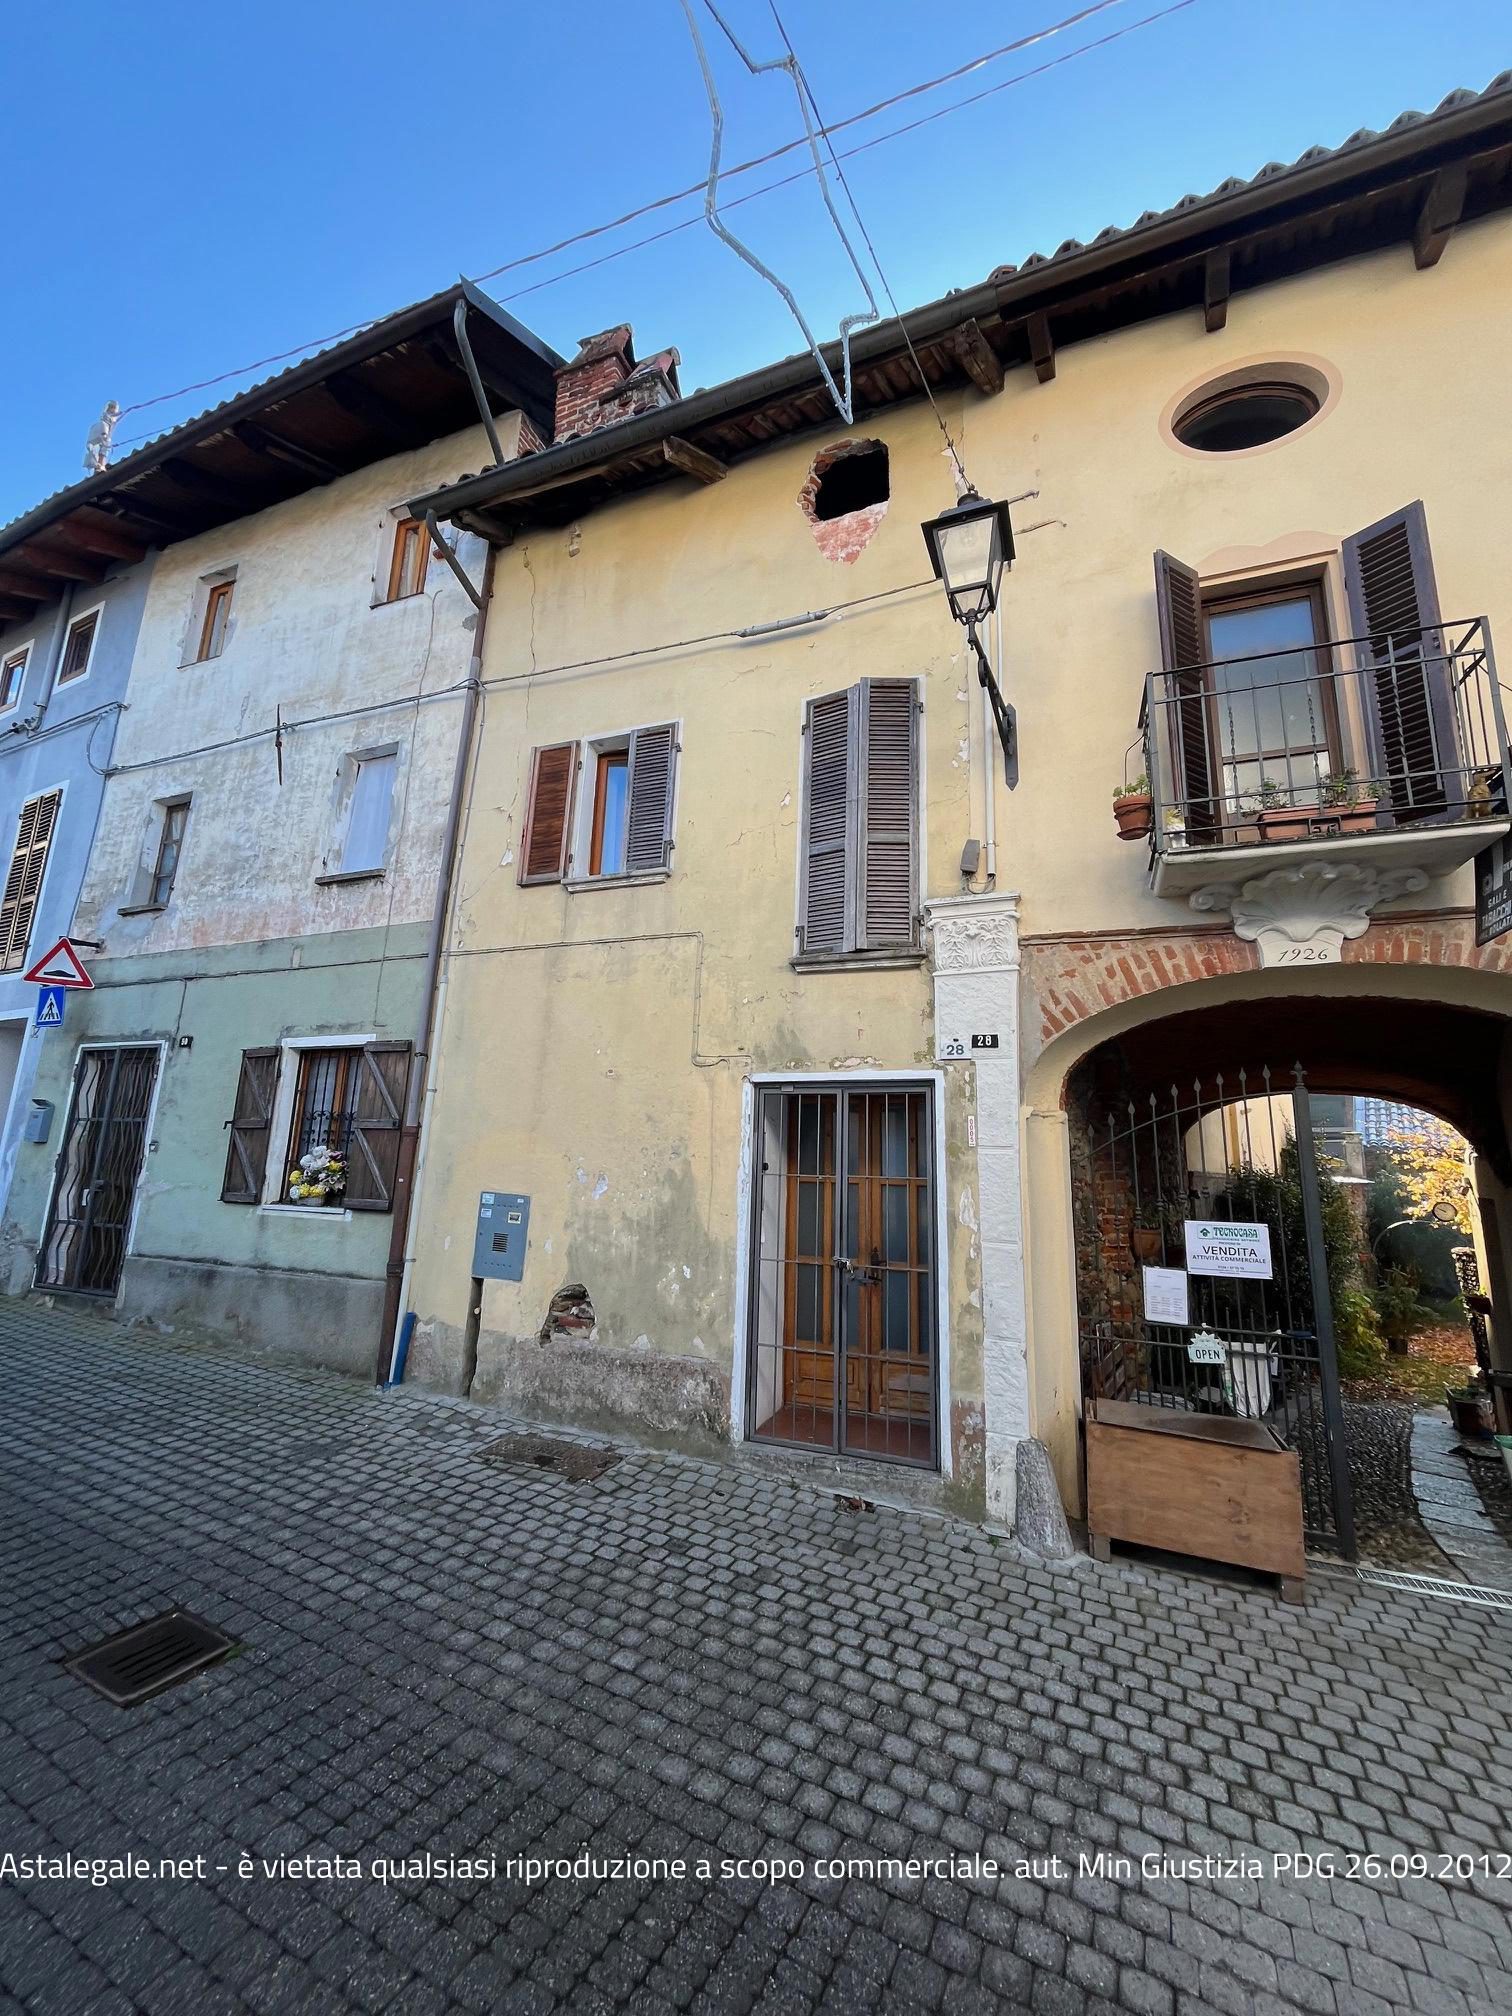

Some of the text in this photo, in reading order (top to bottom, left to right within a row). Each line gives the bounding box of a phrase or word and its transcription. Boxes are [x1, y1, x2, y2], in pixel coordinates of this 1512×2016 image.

[1278, 948, 1329, 962] 1926
[977, 1035, 992, 1046] 28
[946, 1044, 965, 1056] 28
[1213, 1226, 1258, 1239] TECNOCASA
[1202, 1245, 1258, 1258] VENDITA
[1192, 1253, 1266, 1264] ATTIVITÀ COMMERCIALE
[1195, 1349, 1221, 1360] OPEN
